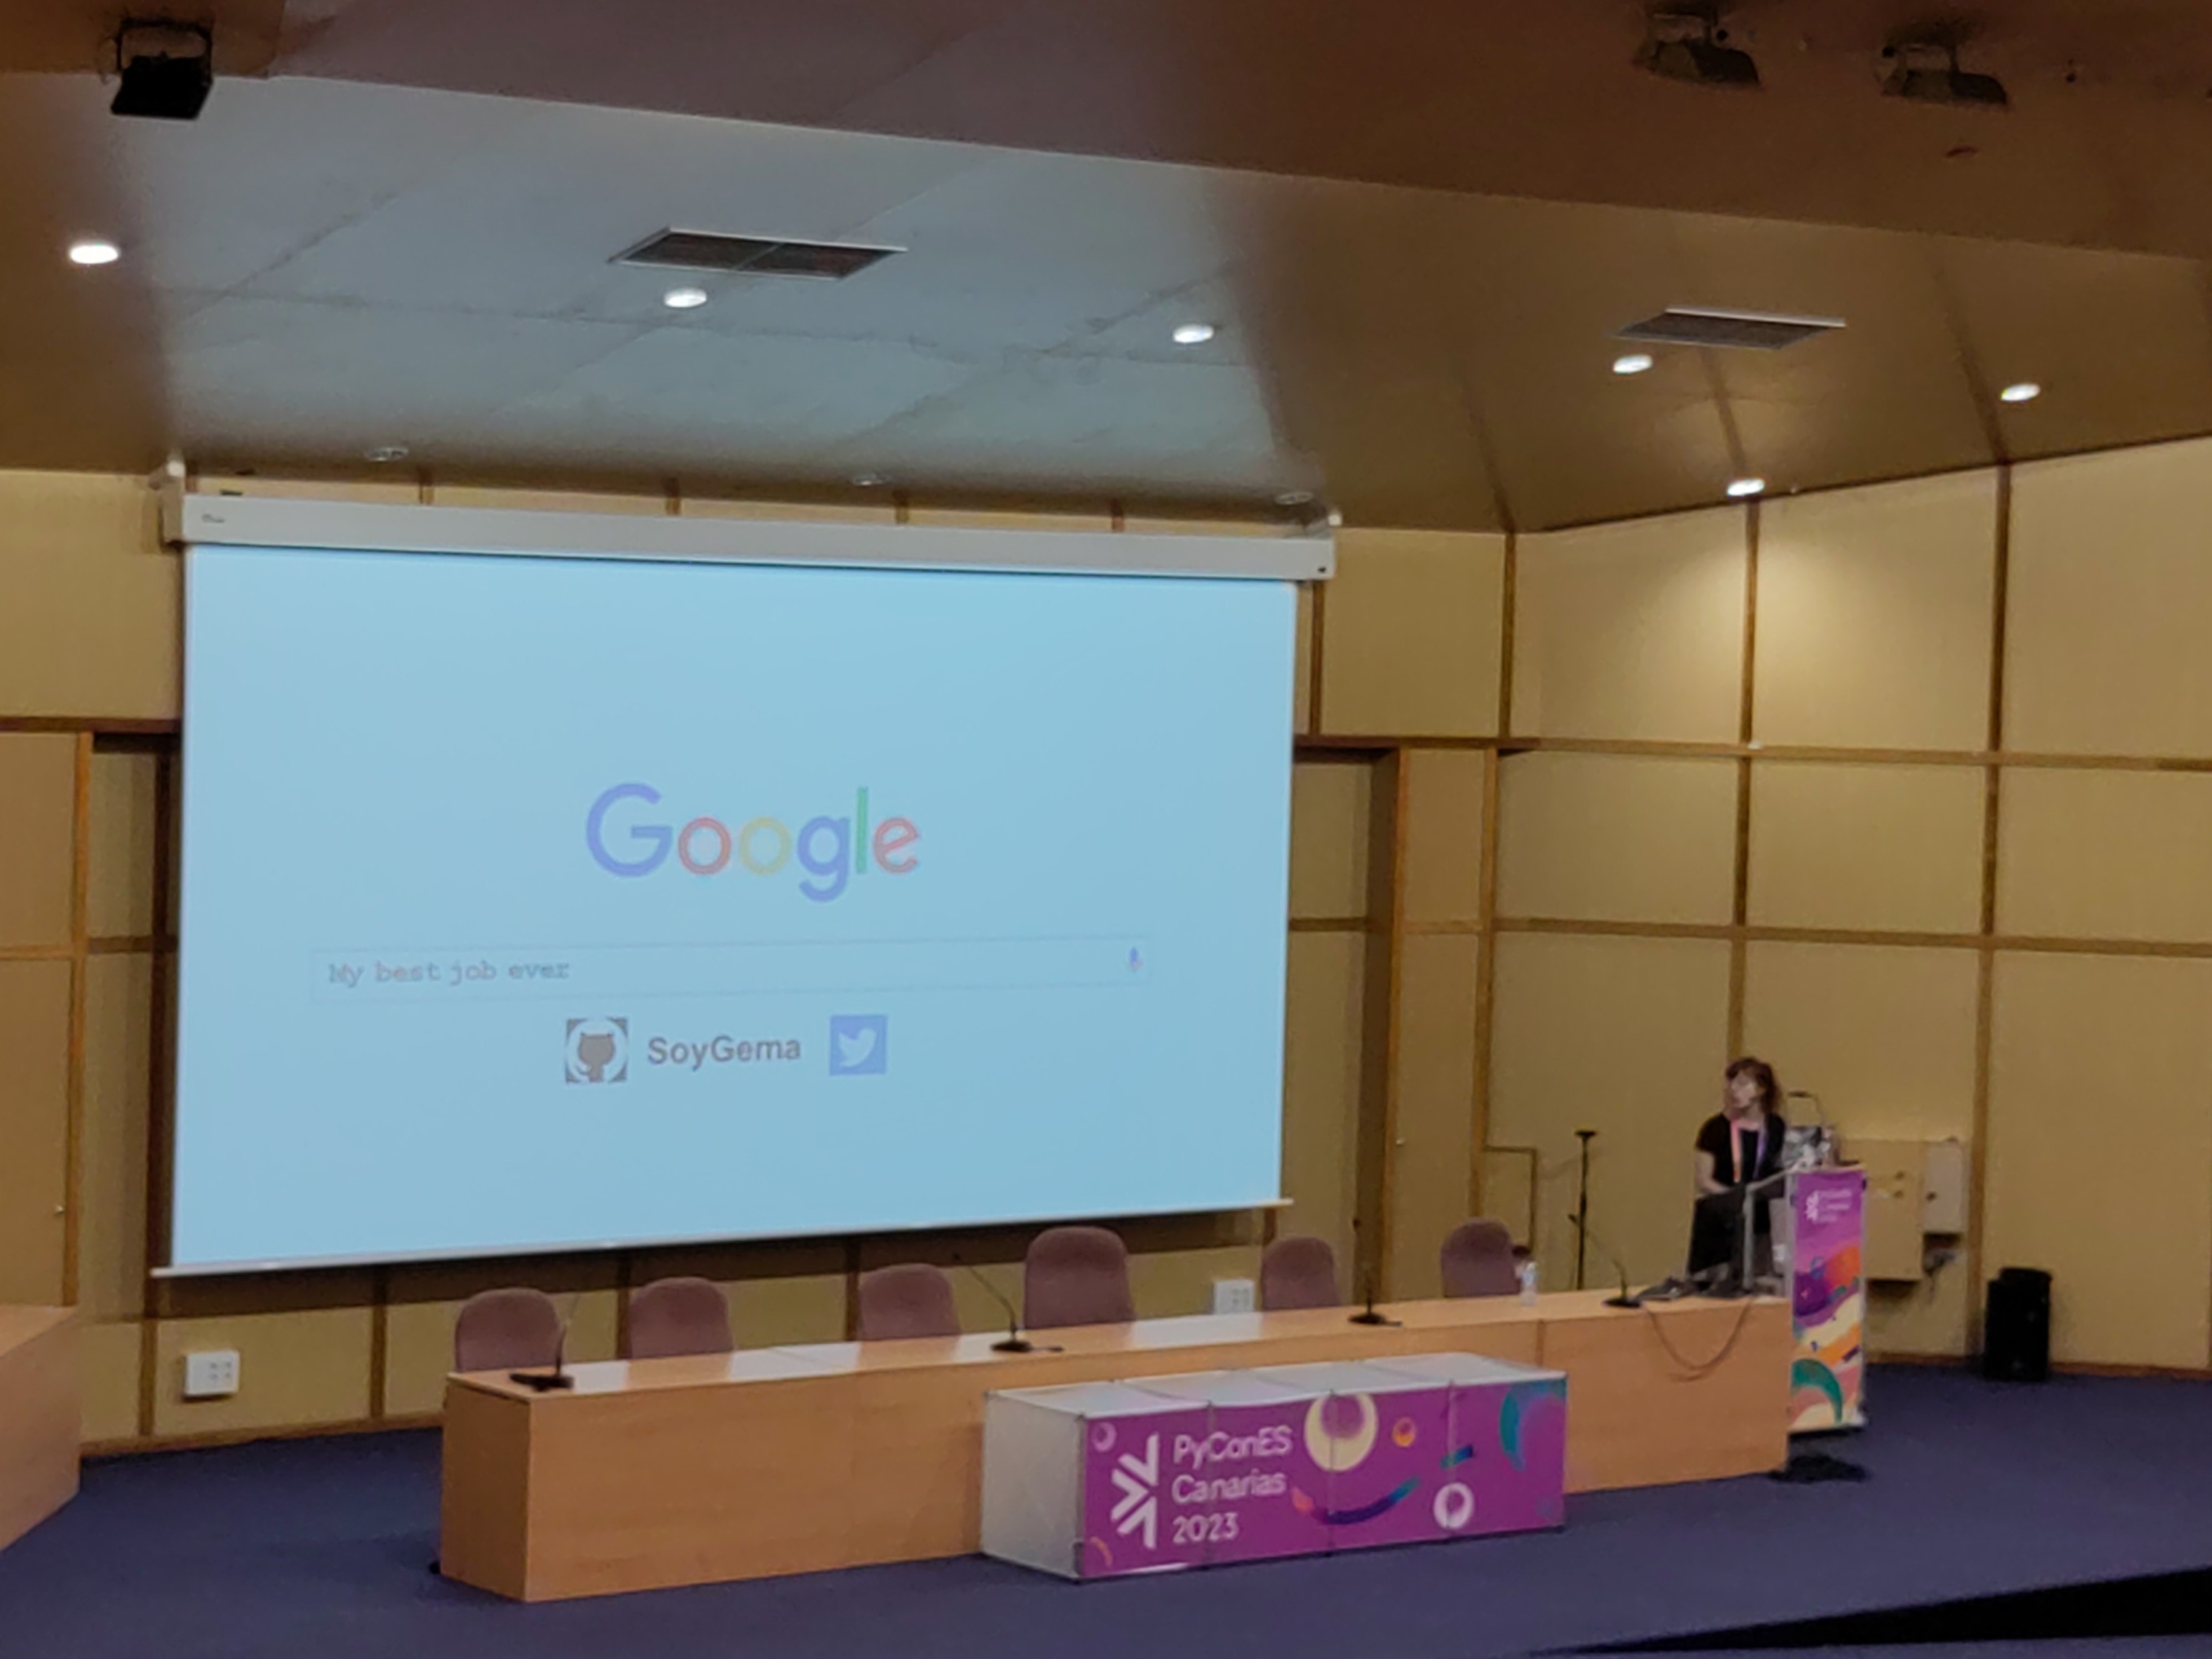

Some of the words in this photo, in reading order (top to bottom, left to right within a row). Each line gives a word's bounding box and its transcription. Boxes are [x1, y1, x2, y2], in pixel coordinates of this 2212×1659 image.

[586, 782, 921, 902] Google
[328, 963, 364, 988] My
[374, 960, 441, 982] best
[450, 958, 497, 986] job
[508, 961, 569, 980] ever
[647, 1034, 802, 1072] SoyGema
[1173, 1424, 1293, 1470] PyConES
[1171, 1467, 1287, 1505] Canarias
[1172, 1511, 1240, 1544] 2023
